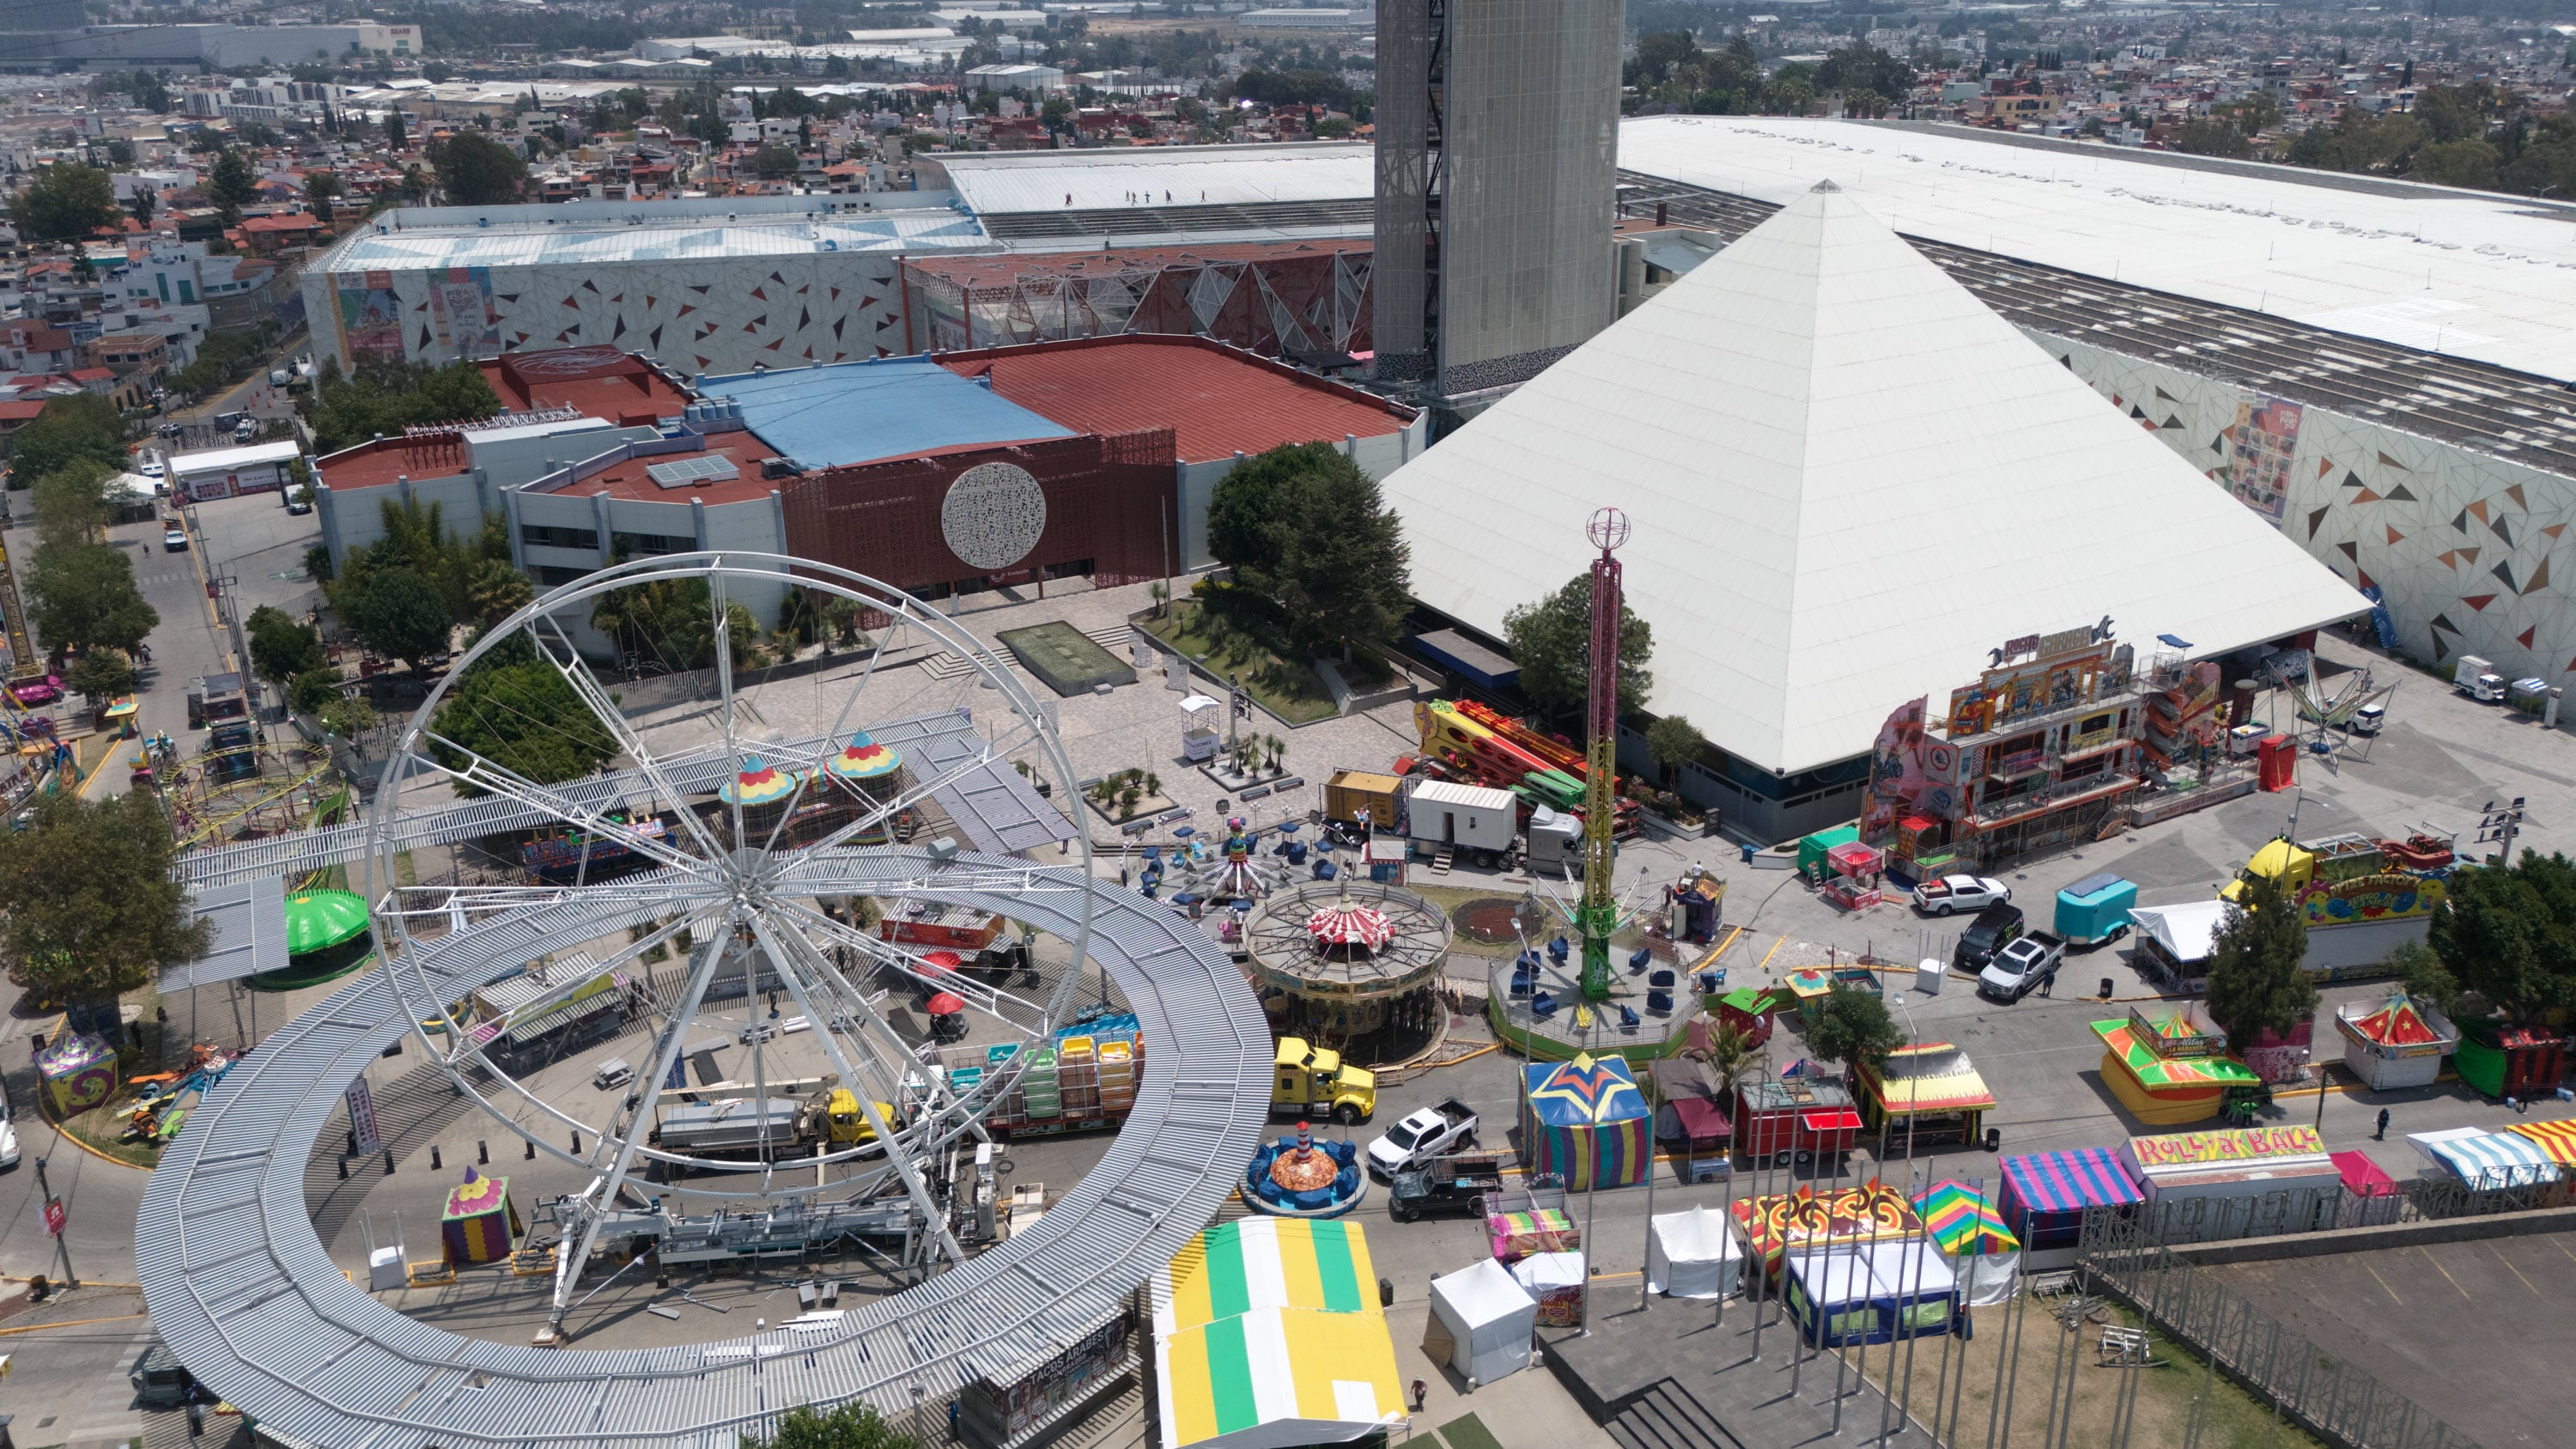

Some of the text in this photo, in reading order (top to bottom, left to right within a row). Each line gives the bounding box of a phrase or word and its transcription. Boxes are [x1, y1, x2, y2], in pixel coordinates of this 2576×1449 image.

[2039, 629, 2089, 655] GARAGE
[2330, 874, 2421, 896] PRIZE FACTORY
[2180, 1038, 2204, 1046] Alitas
[2246, 1128, 2318, 1154] BALL
[1030, 1357, 1065, 1385] TACOS
[1066, 1330, 1105, 1363] ARABES
